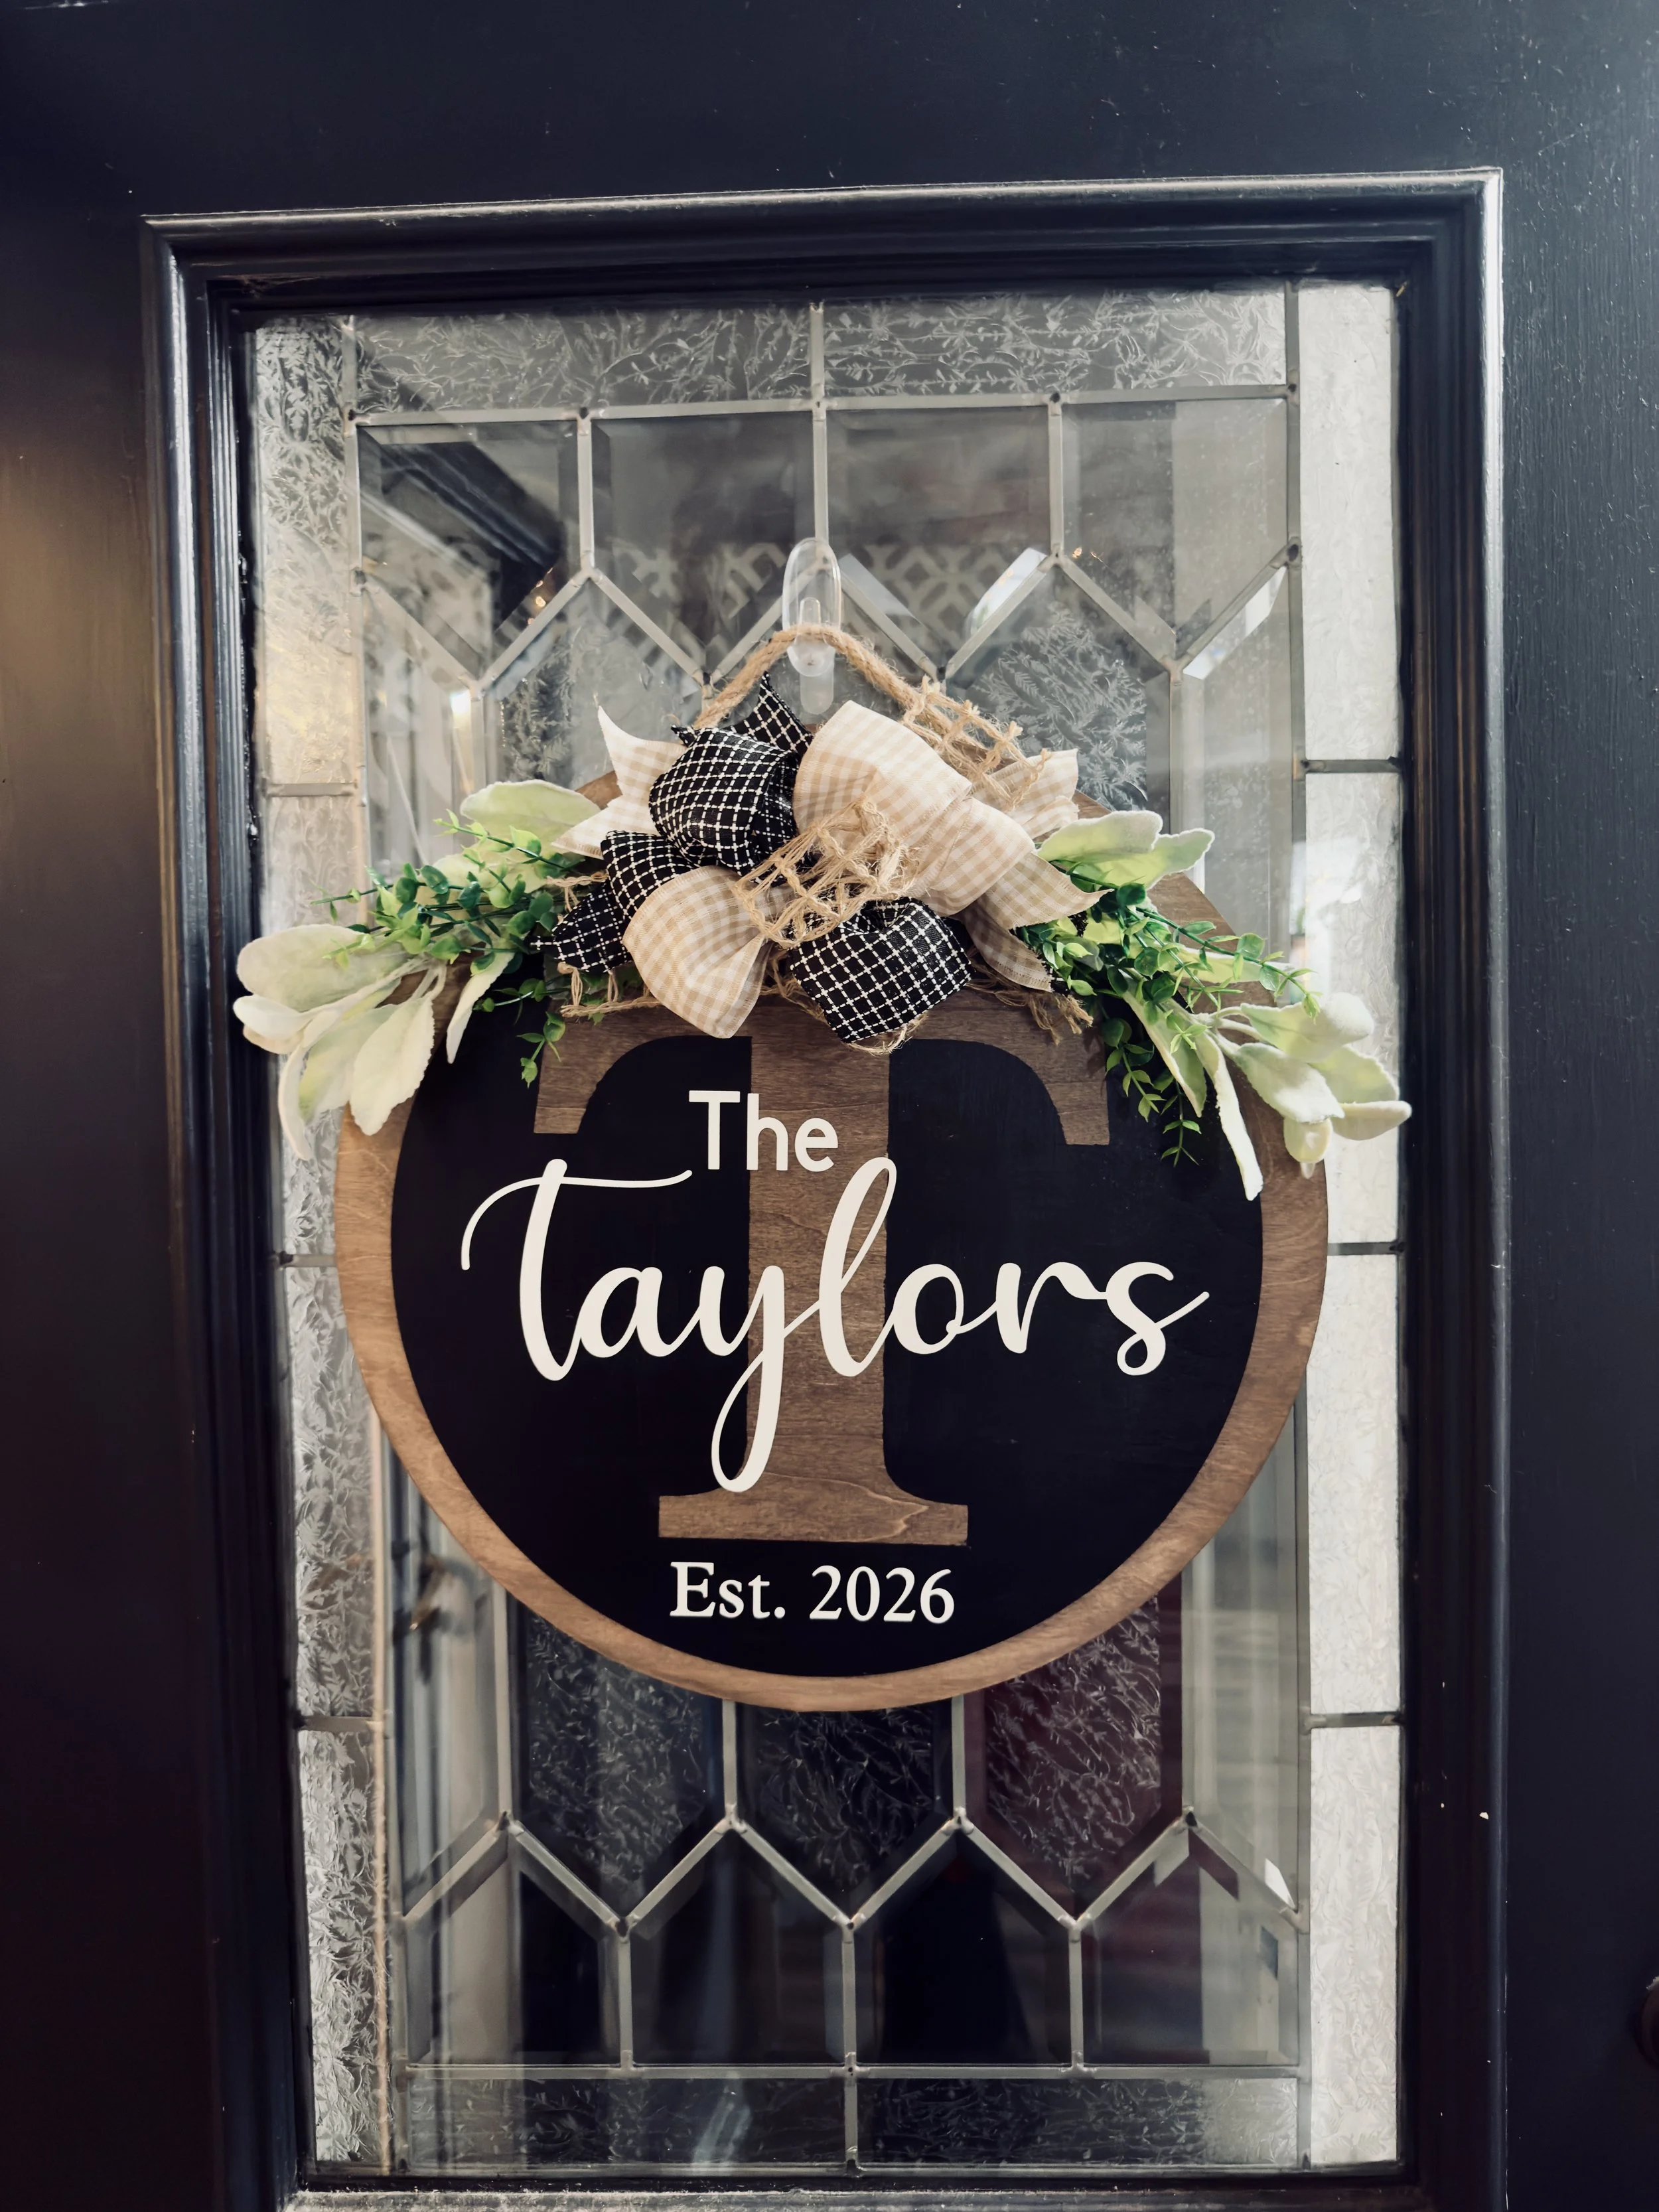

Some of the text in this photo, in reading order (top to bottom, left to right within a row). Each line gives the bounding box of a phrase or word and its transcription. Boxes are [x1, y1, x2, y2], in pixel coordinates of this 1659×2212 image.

[687, 1090, 839, 1172] The
[534, 989, 1110, 1546] T
[669, 1561, 955, 1625] Est. 2026
